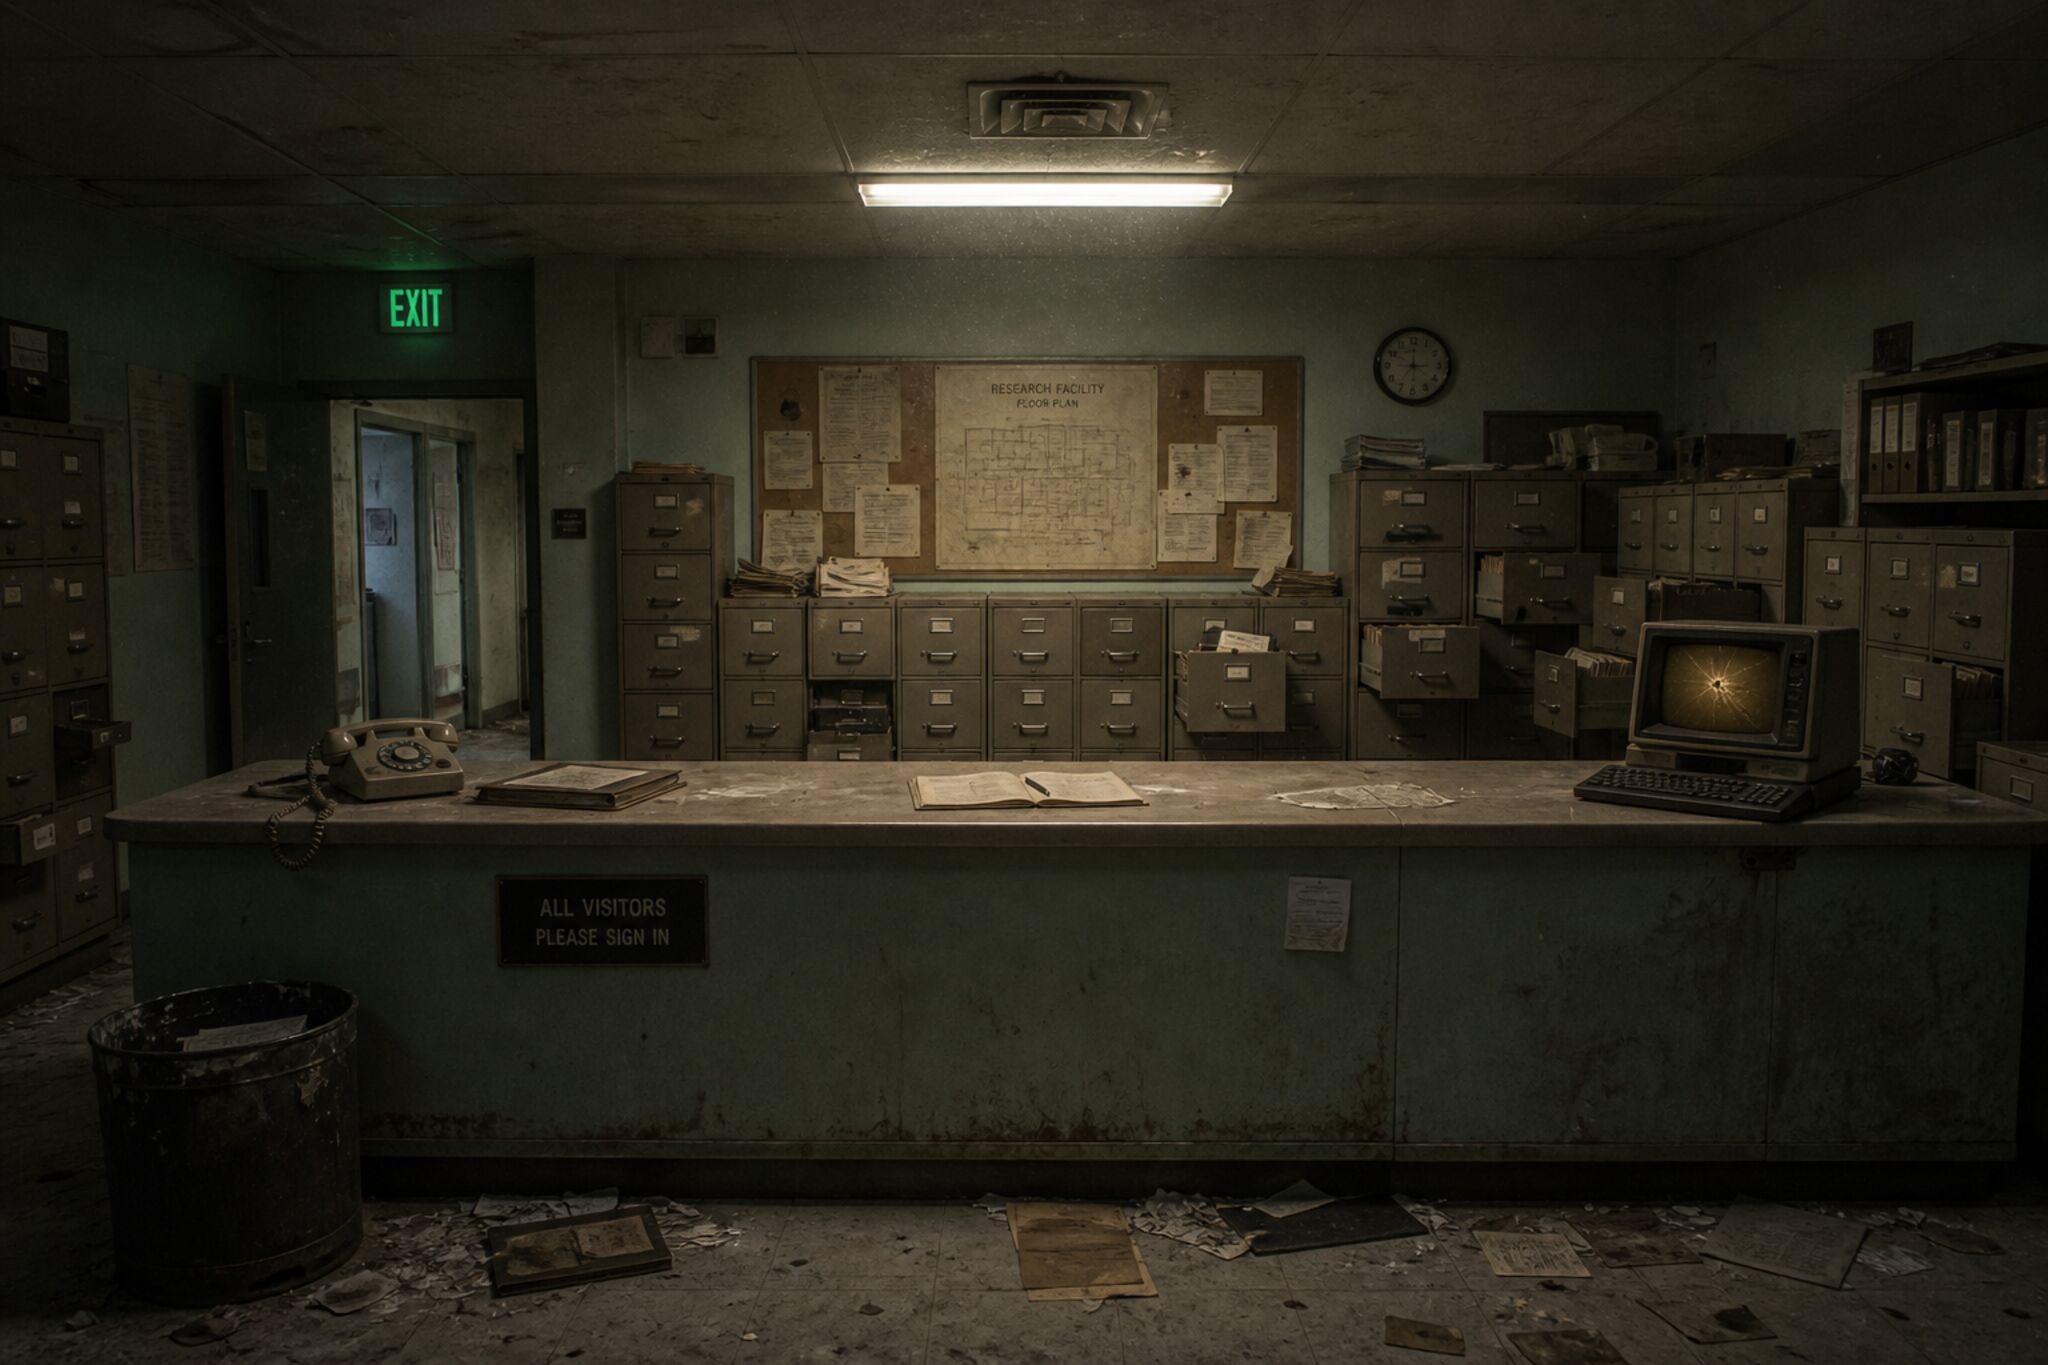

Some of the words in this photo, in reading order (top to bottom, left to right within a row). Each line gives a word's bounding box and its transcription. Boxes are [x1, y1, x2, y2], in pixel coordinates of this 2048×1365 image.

[390, 288, 443, 328] EXIT
[991, 383, 1051, 394] RESEARCH
[1056, 383, 1105, 394] FACILITY
[1053, 398, 1079, 408] PLAN
[539, 898, 574, 917] ALL
[583, 898, 666, 917] VISITORS
[536, 928, 598, 946] PLEASE
[605, 928, 645, 946] SIGN
[653, 928, 670, 946] IN
